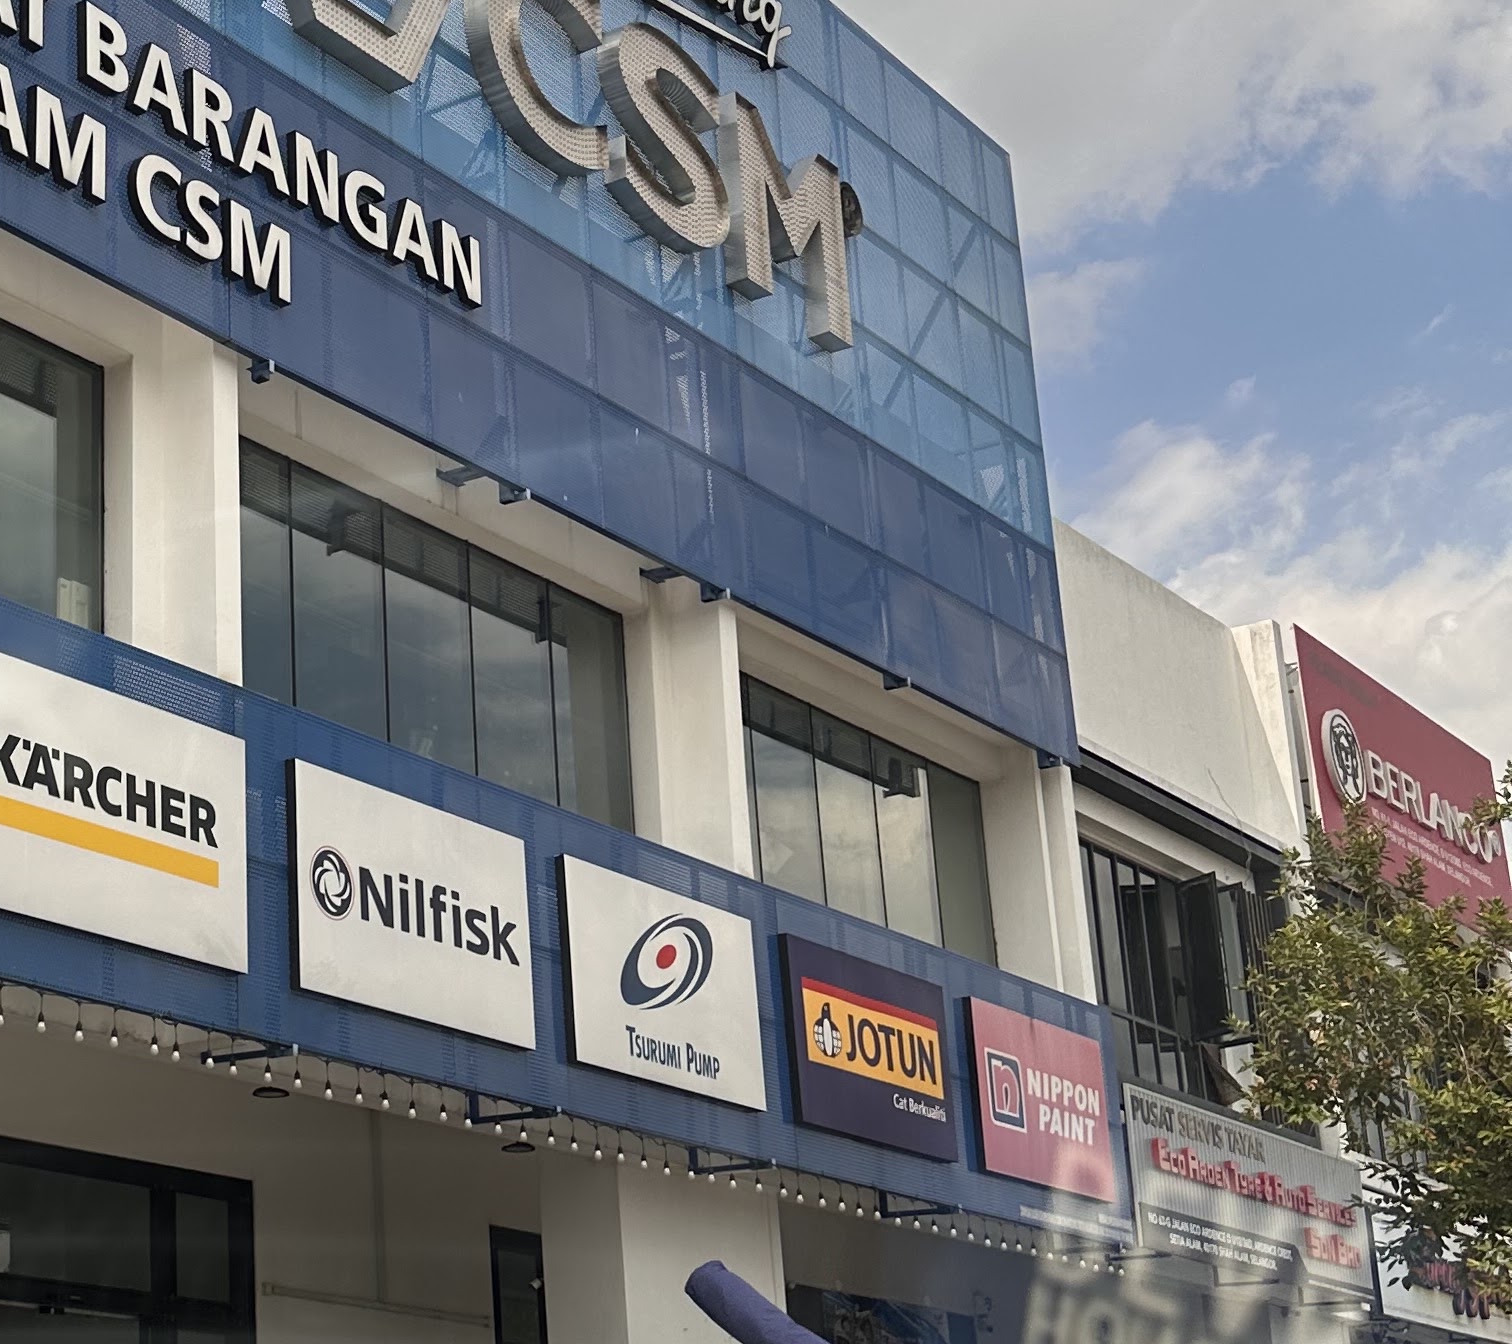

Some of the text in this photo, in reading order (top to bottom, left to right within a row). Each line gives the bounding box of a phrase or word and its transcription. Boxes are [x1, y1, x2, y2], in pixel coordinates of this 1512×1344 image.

[76, 0, 482, 309] BARANGAN
[128, 154, 292, 308] CSM
[358, 865, 521, 967] Nilfisk
[686, 1042, 720, 1080] PUMP
[846, 1013, 938, 1086] JOTUN
[1026, 1067, 1101, 1118] NIPPON
[1039, 1104, 1096, 1146] PAINT
[1131, 1094, 1175, 1134] PUSAT
[1178, 1110, 1225, 1151] SERVIS
